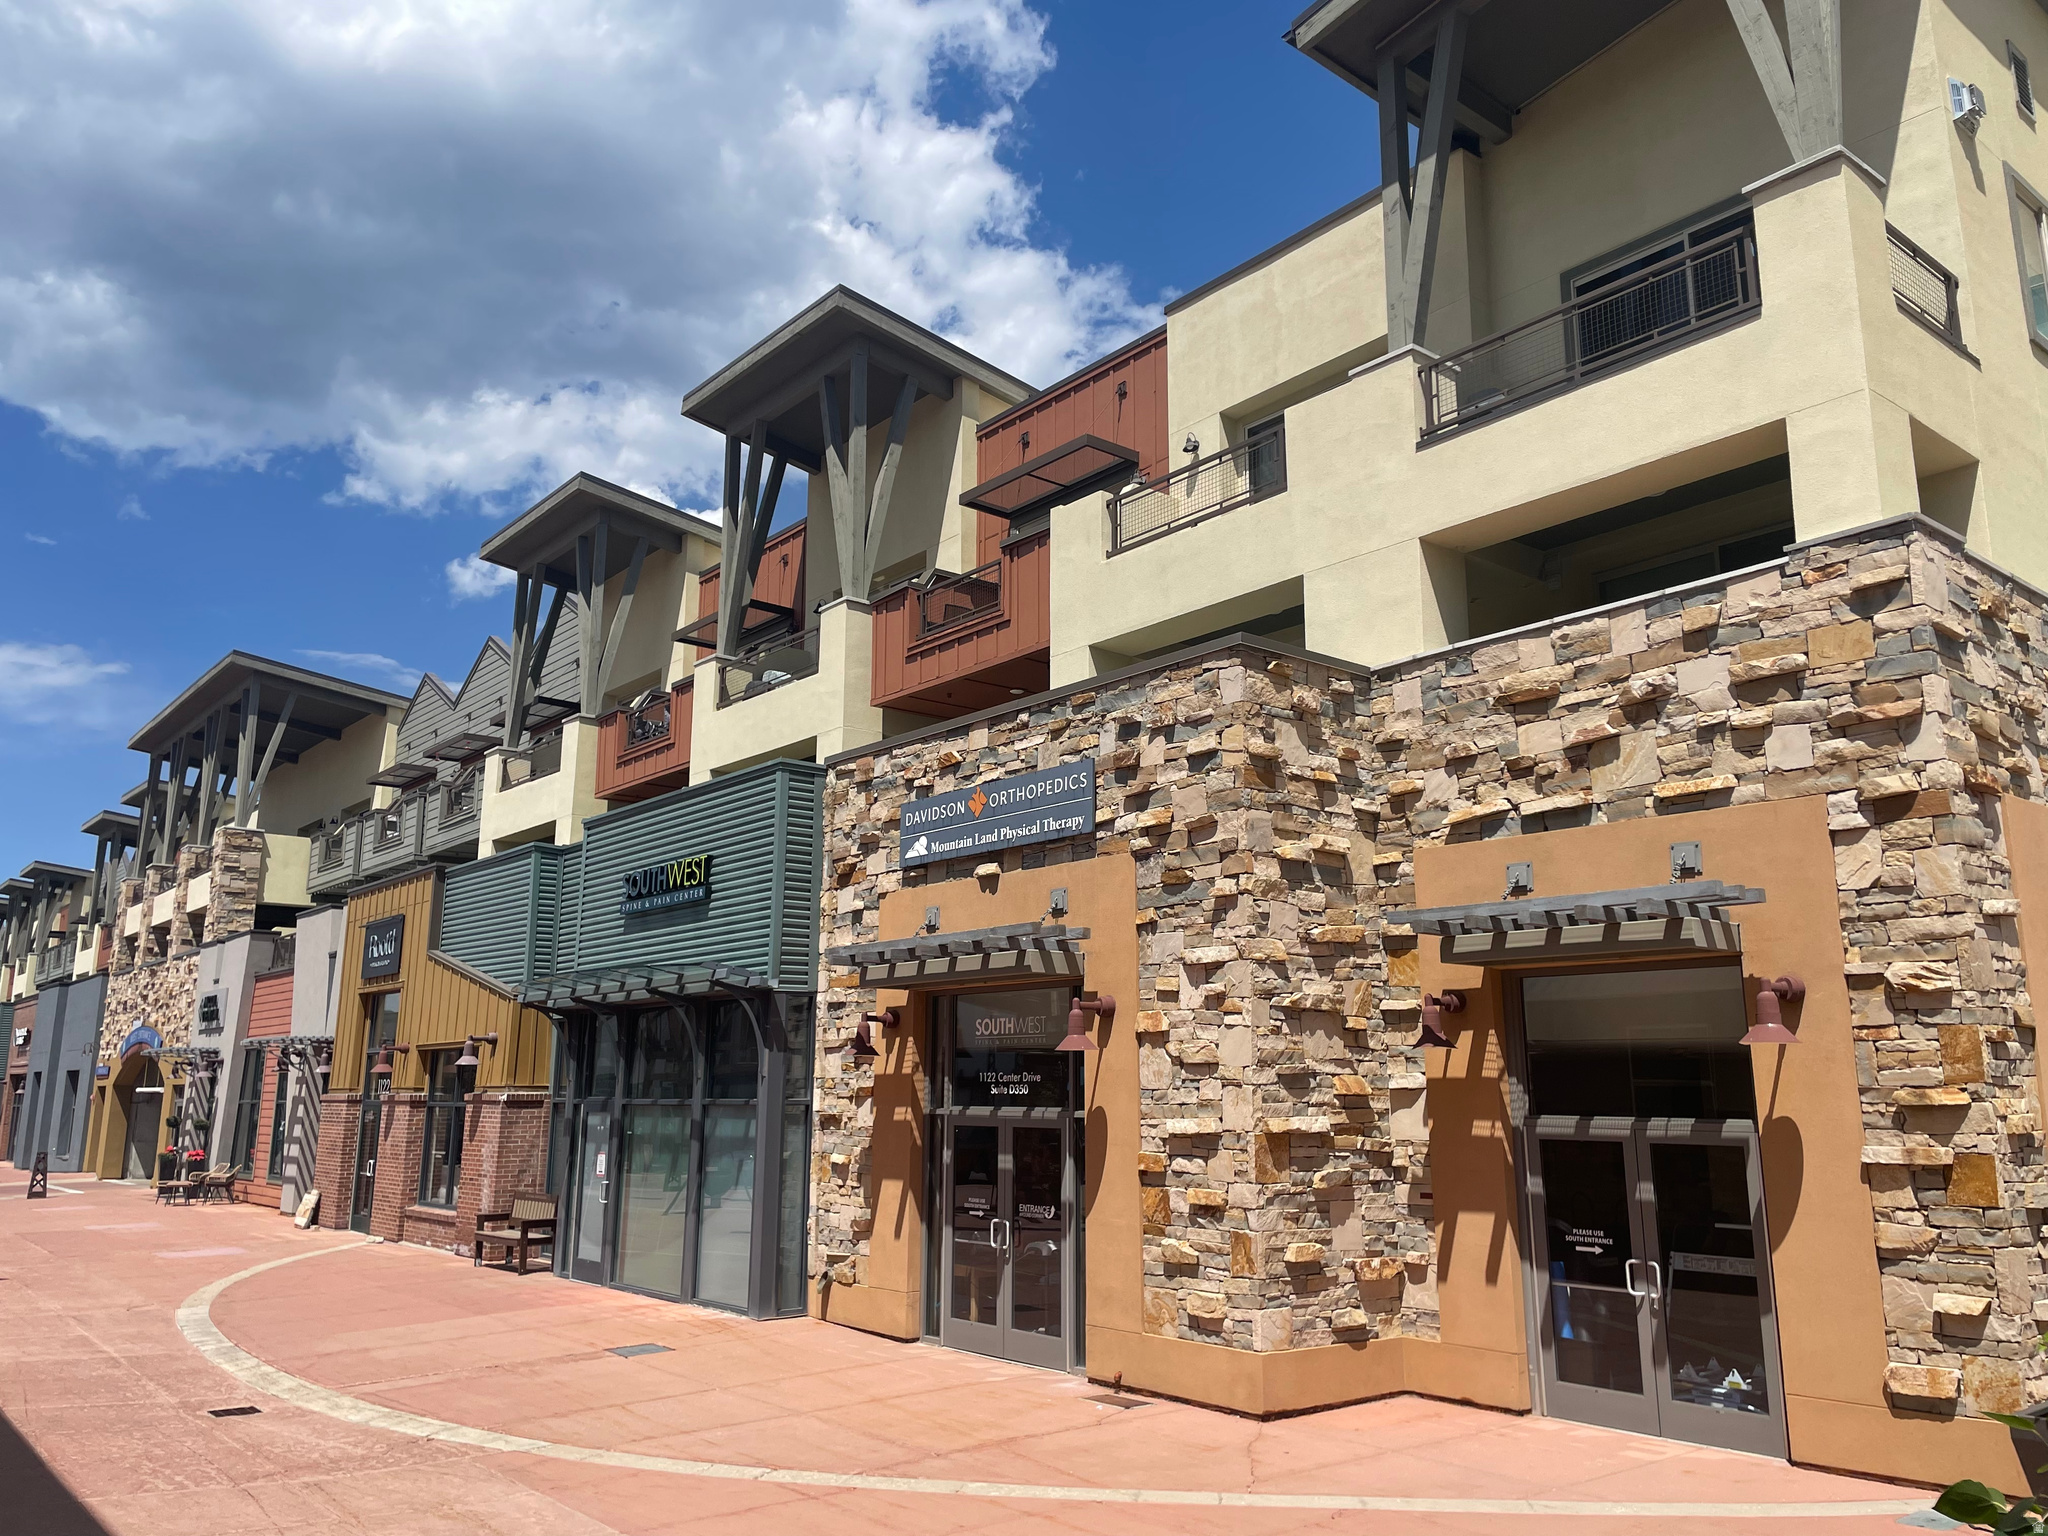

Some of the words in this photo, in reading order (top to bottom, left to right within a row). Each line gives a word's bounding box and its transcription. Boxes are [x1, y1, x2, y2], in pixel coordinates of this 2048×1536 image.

[905, 800, 965, 827] DAVIDSON
[989, 772, 1087, 808] ORTHOPEDICS
[930, 836, 973, 854] Mountain
[974, 828, 998, 845] Land
[999, 820, 1040, 842] Physical
[1042, 815, 1085, 832] Therapy
[622, 854, 708, 899] SOUTHWEST
[621, 901, 641, 912] SPINE
[653, 896, 671, 906] PAIN
[674, 889, 704, 901] CENTER
[975, 1016, 1046, 1035] SOUTHWEST
[979, 1072, 996, 1082] 1122
[997, 1072, 1021, 1082] Center
[1022, 1072, 1041, 1082] Drive
[377, 1079, 391, 1094] 1122
[990, 1084, 1008, 1094] Suite
[1009, 1084, 1029, 1094] D350
[1019, 1204, 1050, 1214] ENTRANCE
[1585, 1237, 1613, 1245] ENTRANCE
